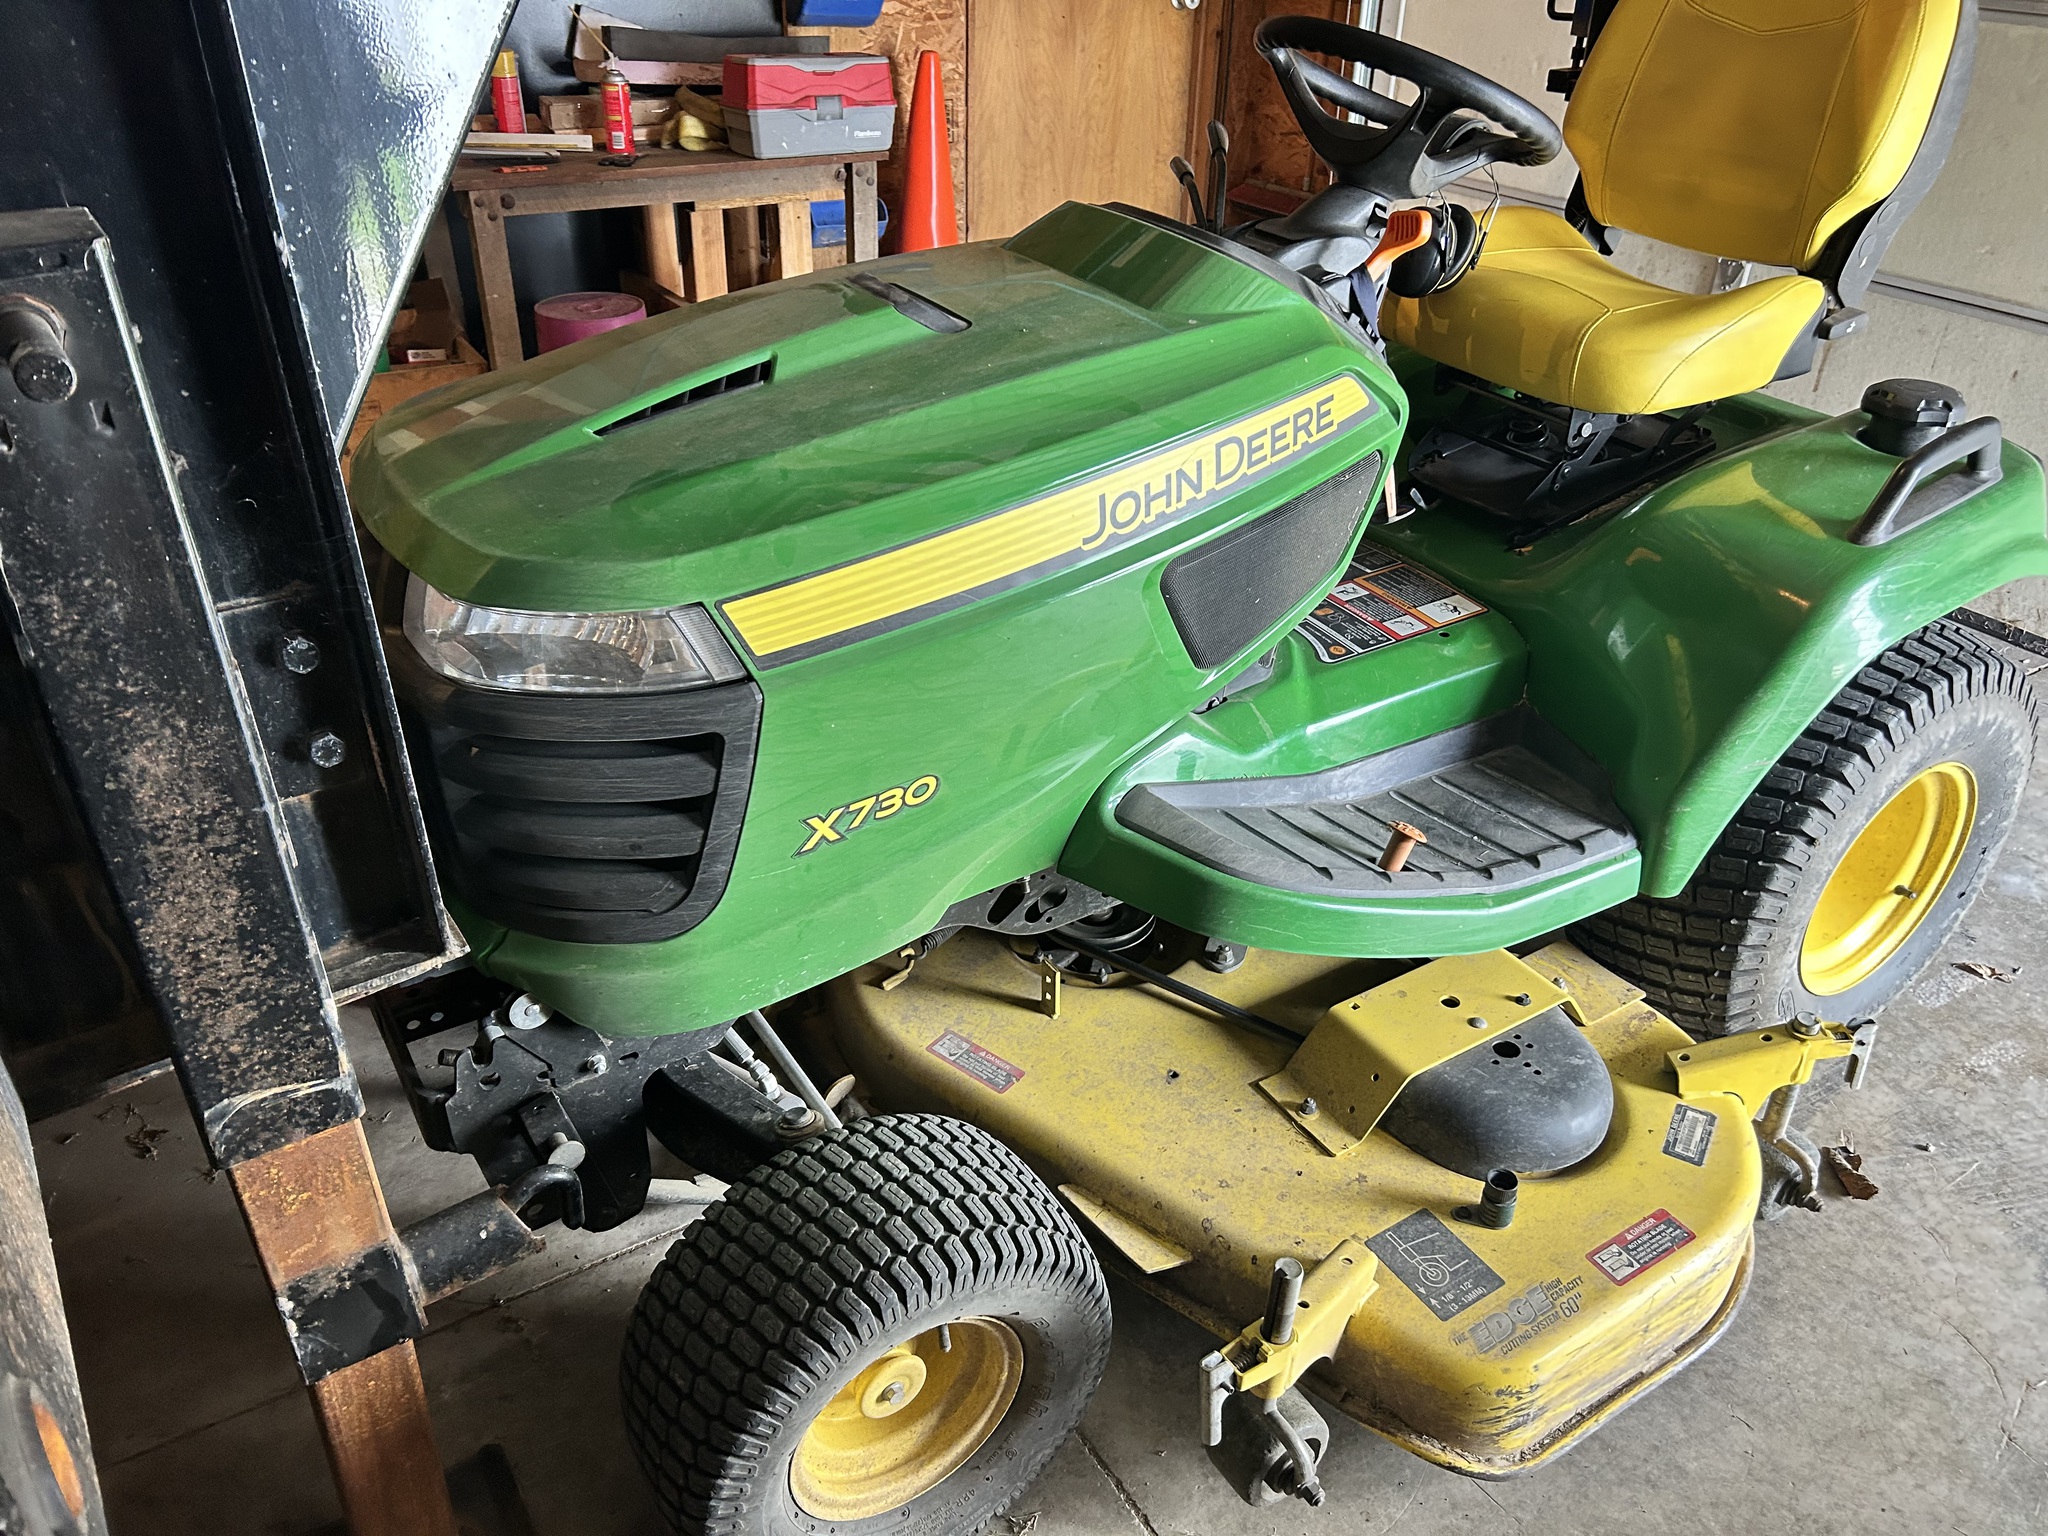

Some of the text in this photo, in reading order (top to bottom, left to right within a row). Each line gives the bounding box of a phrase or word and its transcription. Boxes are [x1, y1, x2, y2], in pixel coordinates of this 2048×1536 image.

[1082, 394, 1335, 547] JOHN DEERE
[791, 774, 940, 858] X730
[986, 1053, 1011, 1071] DANGER
[1629, 1217, 1656, 1235] DANGER
[1441, 1289, 1455, 1302] 1/8"
[1460, 1279, 1473, 1291] 1/2"
[1461, 1286, 1487, 1303] 13MM)
[1544, 1277, 1563, 1292] HIGH
[1550, 1275, 1584, 1301] CAPACITY
[1452, 1284, 1554, 1354] THE EDGE
[1500, 1291, 1582, 1355] CUTTING SYSTEM 60"
